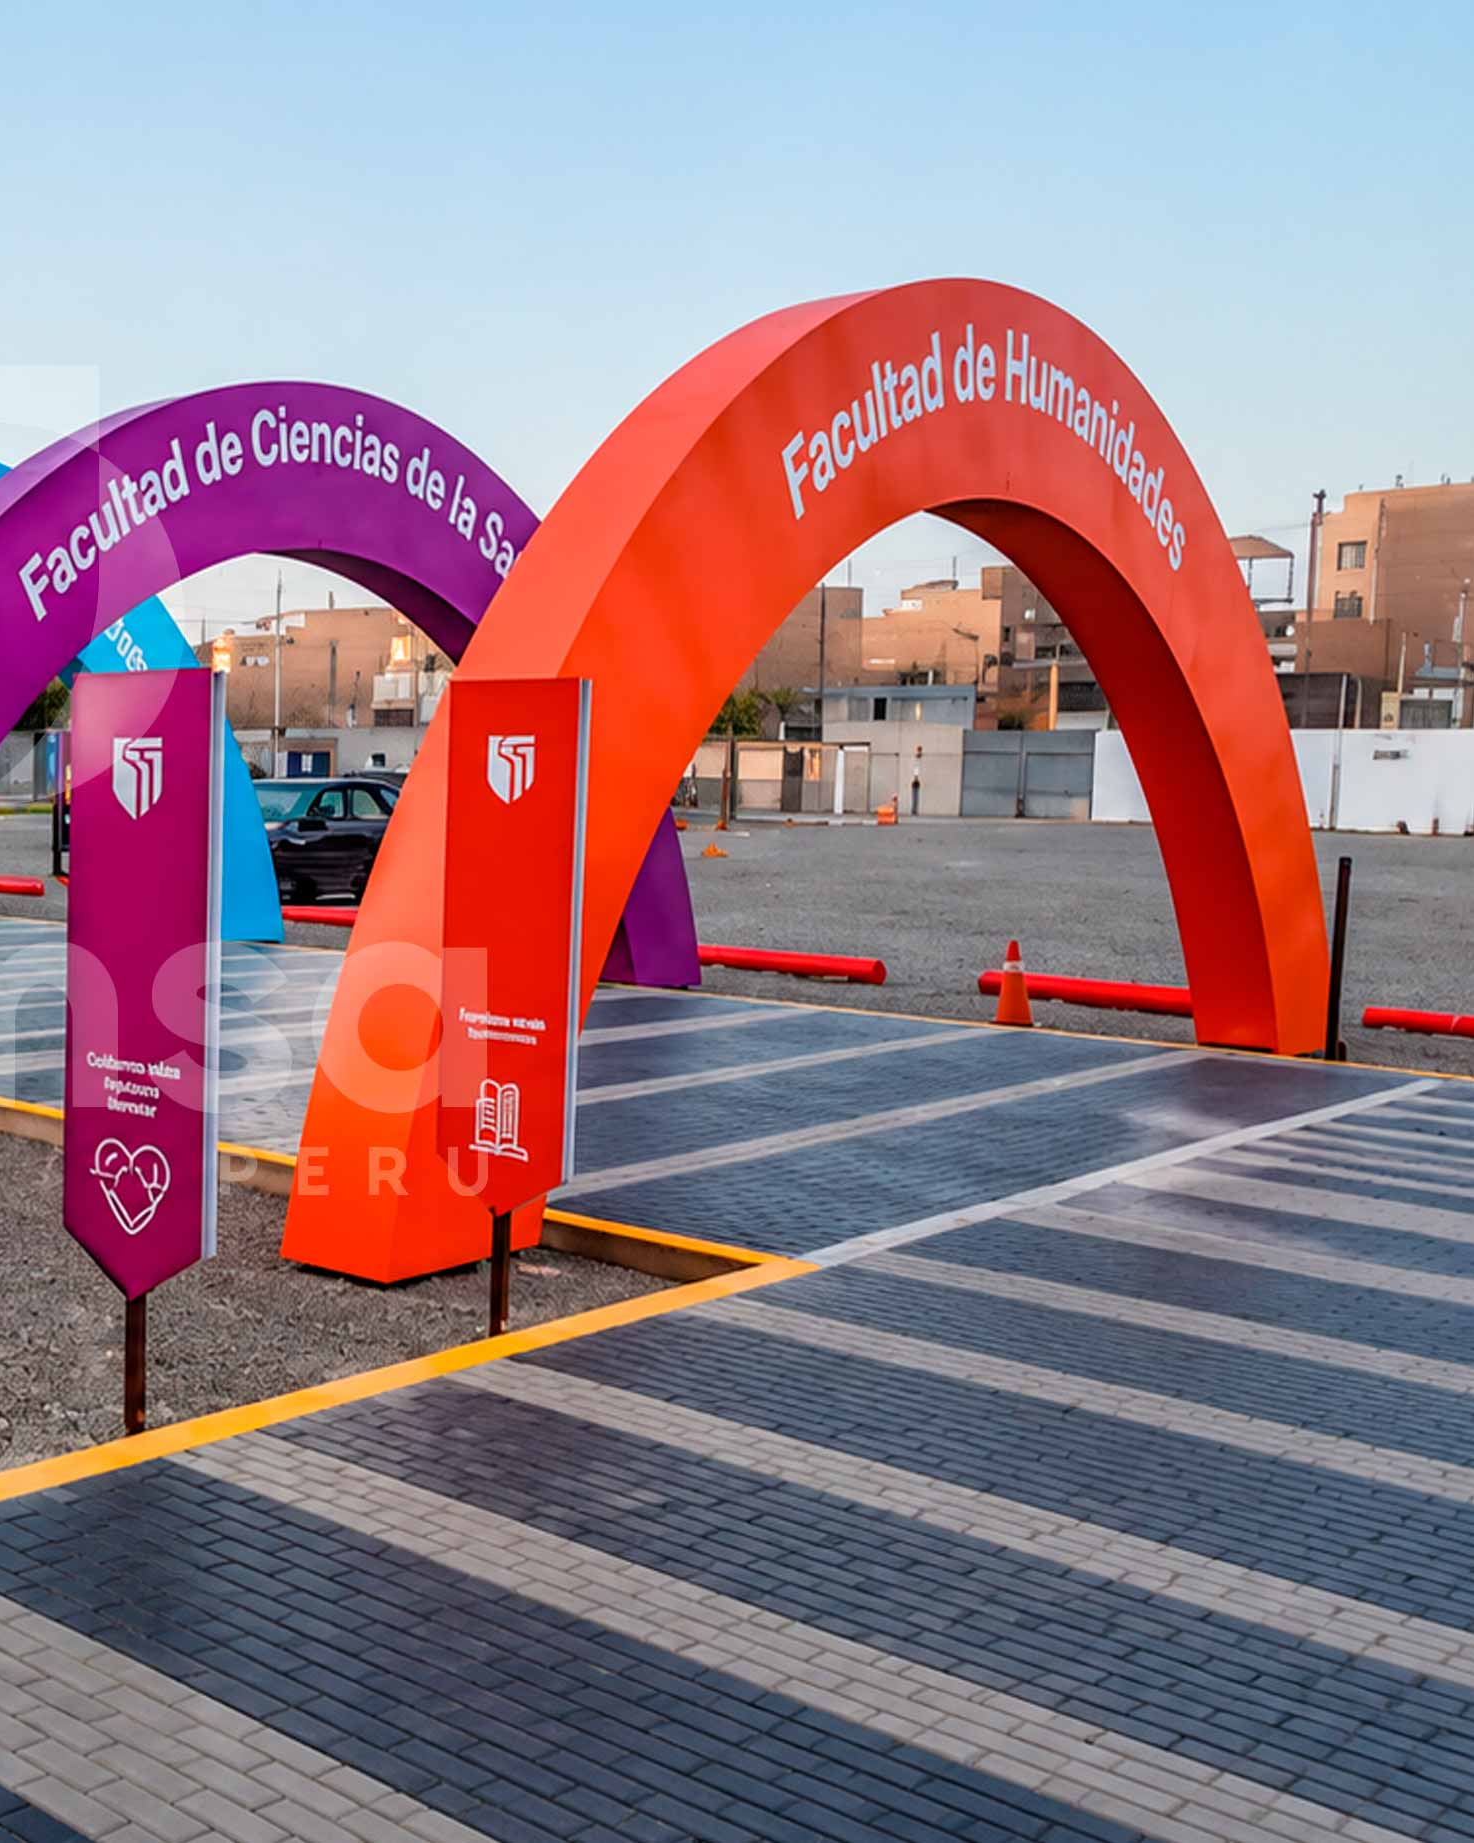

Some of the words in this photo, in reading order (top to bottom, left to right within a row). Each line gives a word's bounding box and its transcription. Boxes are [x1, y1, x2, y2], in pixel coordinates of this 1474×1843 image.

[17, 437, 191, 623] Facultad
[194, 421, 244, 486] de
[250, 404, 401, 484] Ciencias
[406, 447, 446, 511] de
[448, 474, 477, 541] la
[779, 330, 945, 521] Facultad
[952, 322, 997, 403] de
[1004, 328, 1187, 573] Humanidades
